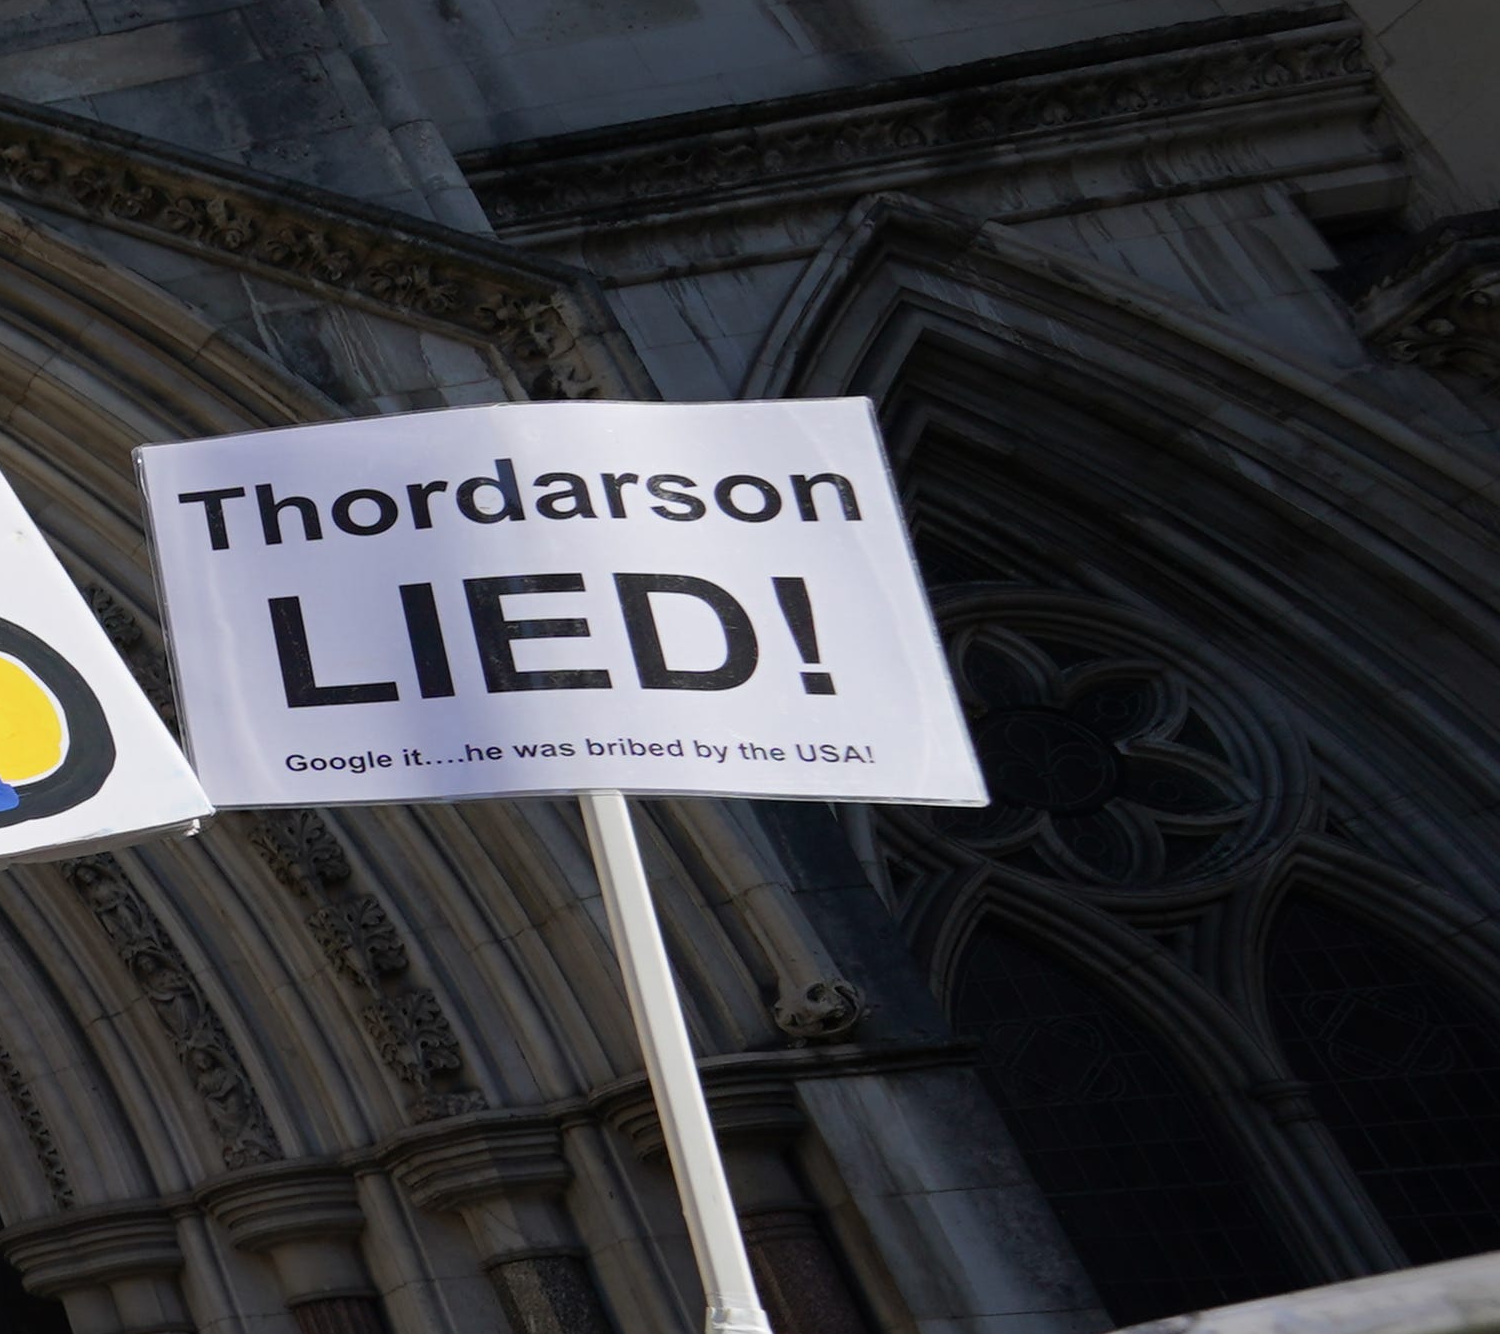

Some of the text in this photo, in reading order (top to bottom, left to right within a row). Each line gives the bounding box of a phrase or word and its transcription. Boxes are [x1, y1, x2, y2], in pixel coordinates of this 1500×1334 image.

[179, 458, 862, 551] Thordarson
[267, 572, 839, 709] LIED!
[285, 748, 398, 774] Google
[512, 739, 577, 761] was
[586, 737, 687, 760] bribed
[694, 740, 729, 765] by
[738, 740, 787, 762] the
[797, 742, 876, 765] USA!
